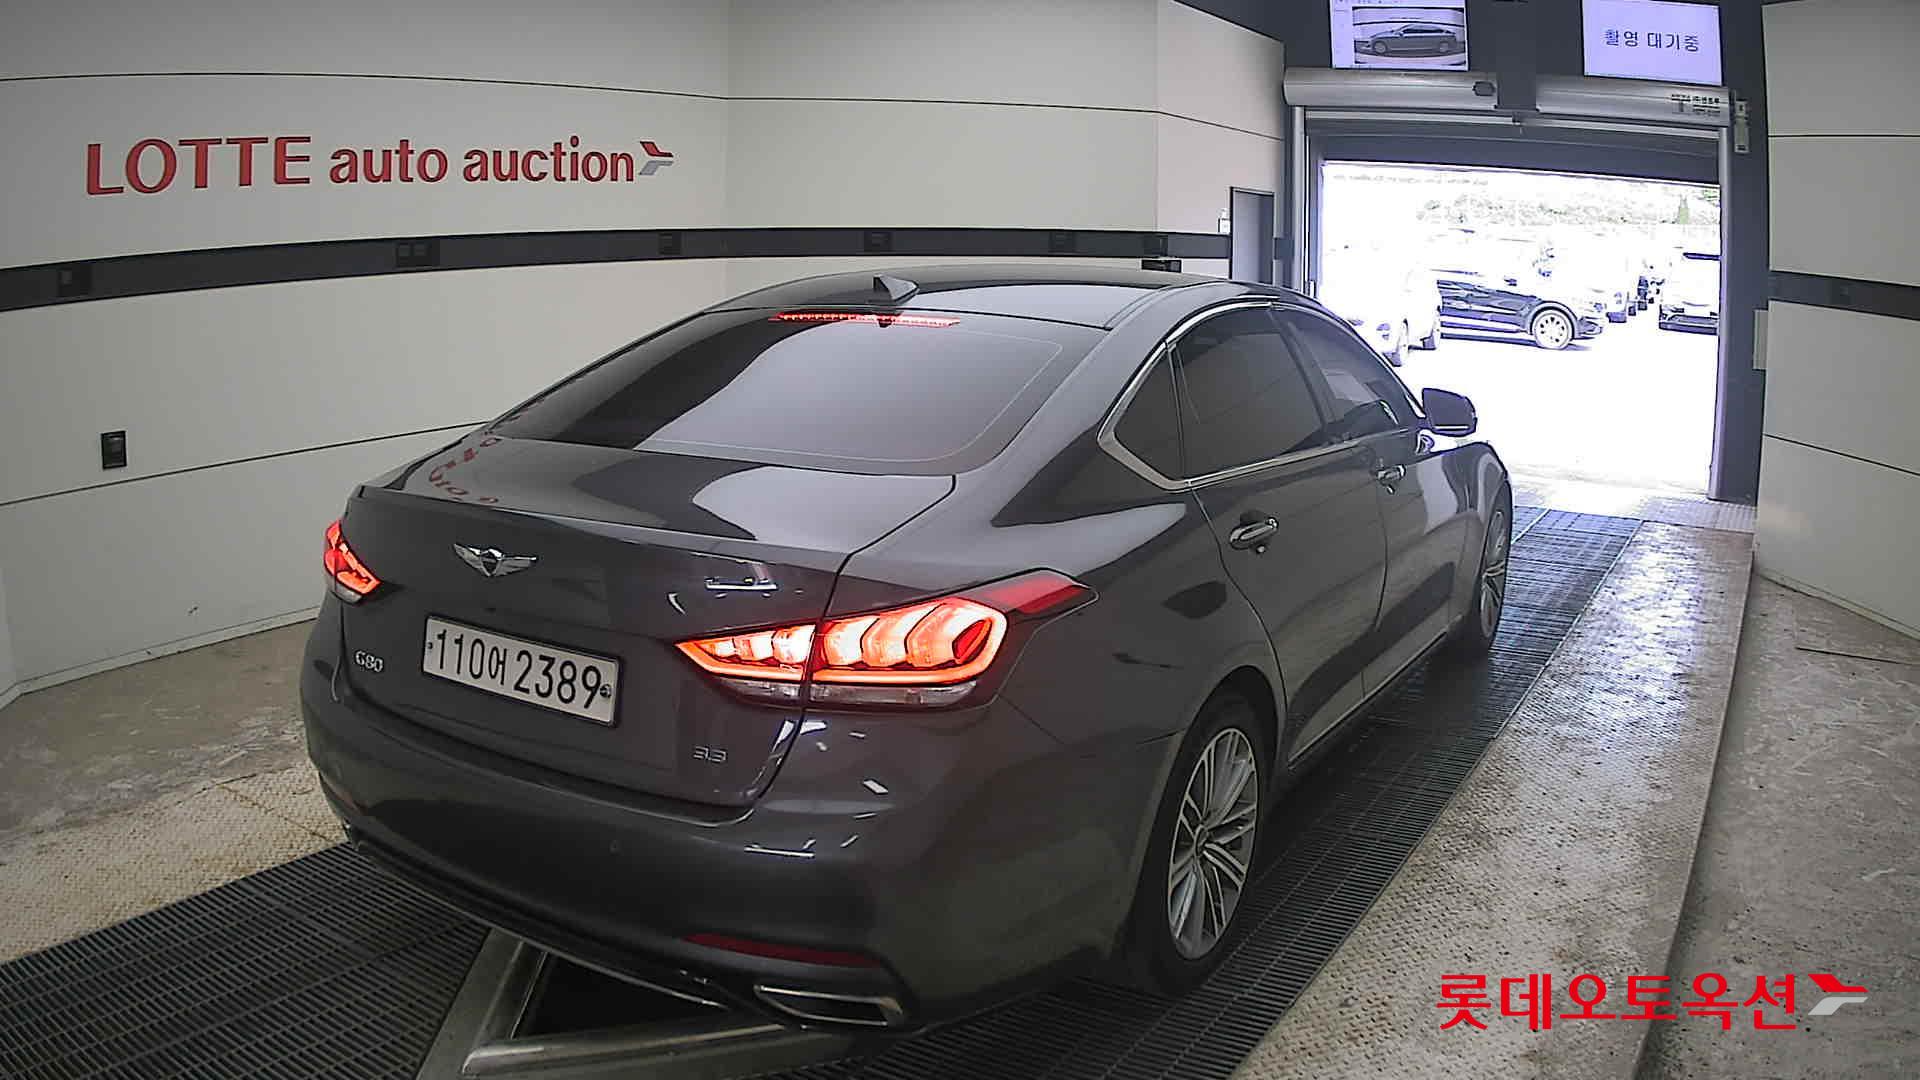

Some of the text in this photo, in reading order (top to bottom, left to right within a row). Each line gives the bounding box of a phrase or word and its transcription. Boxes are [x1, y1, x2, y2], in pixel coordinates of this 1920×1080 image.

[86, 135, 634, 195] LOTTE auto auction
[355, 650, 384, 672] G80
